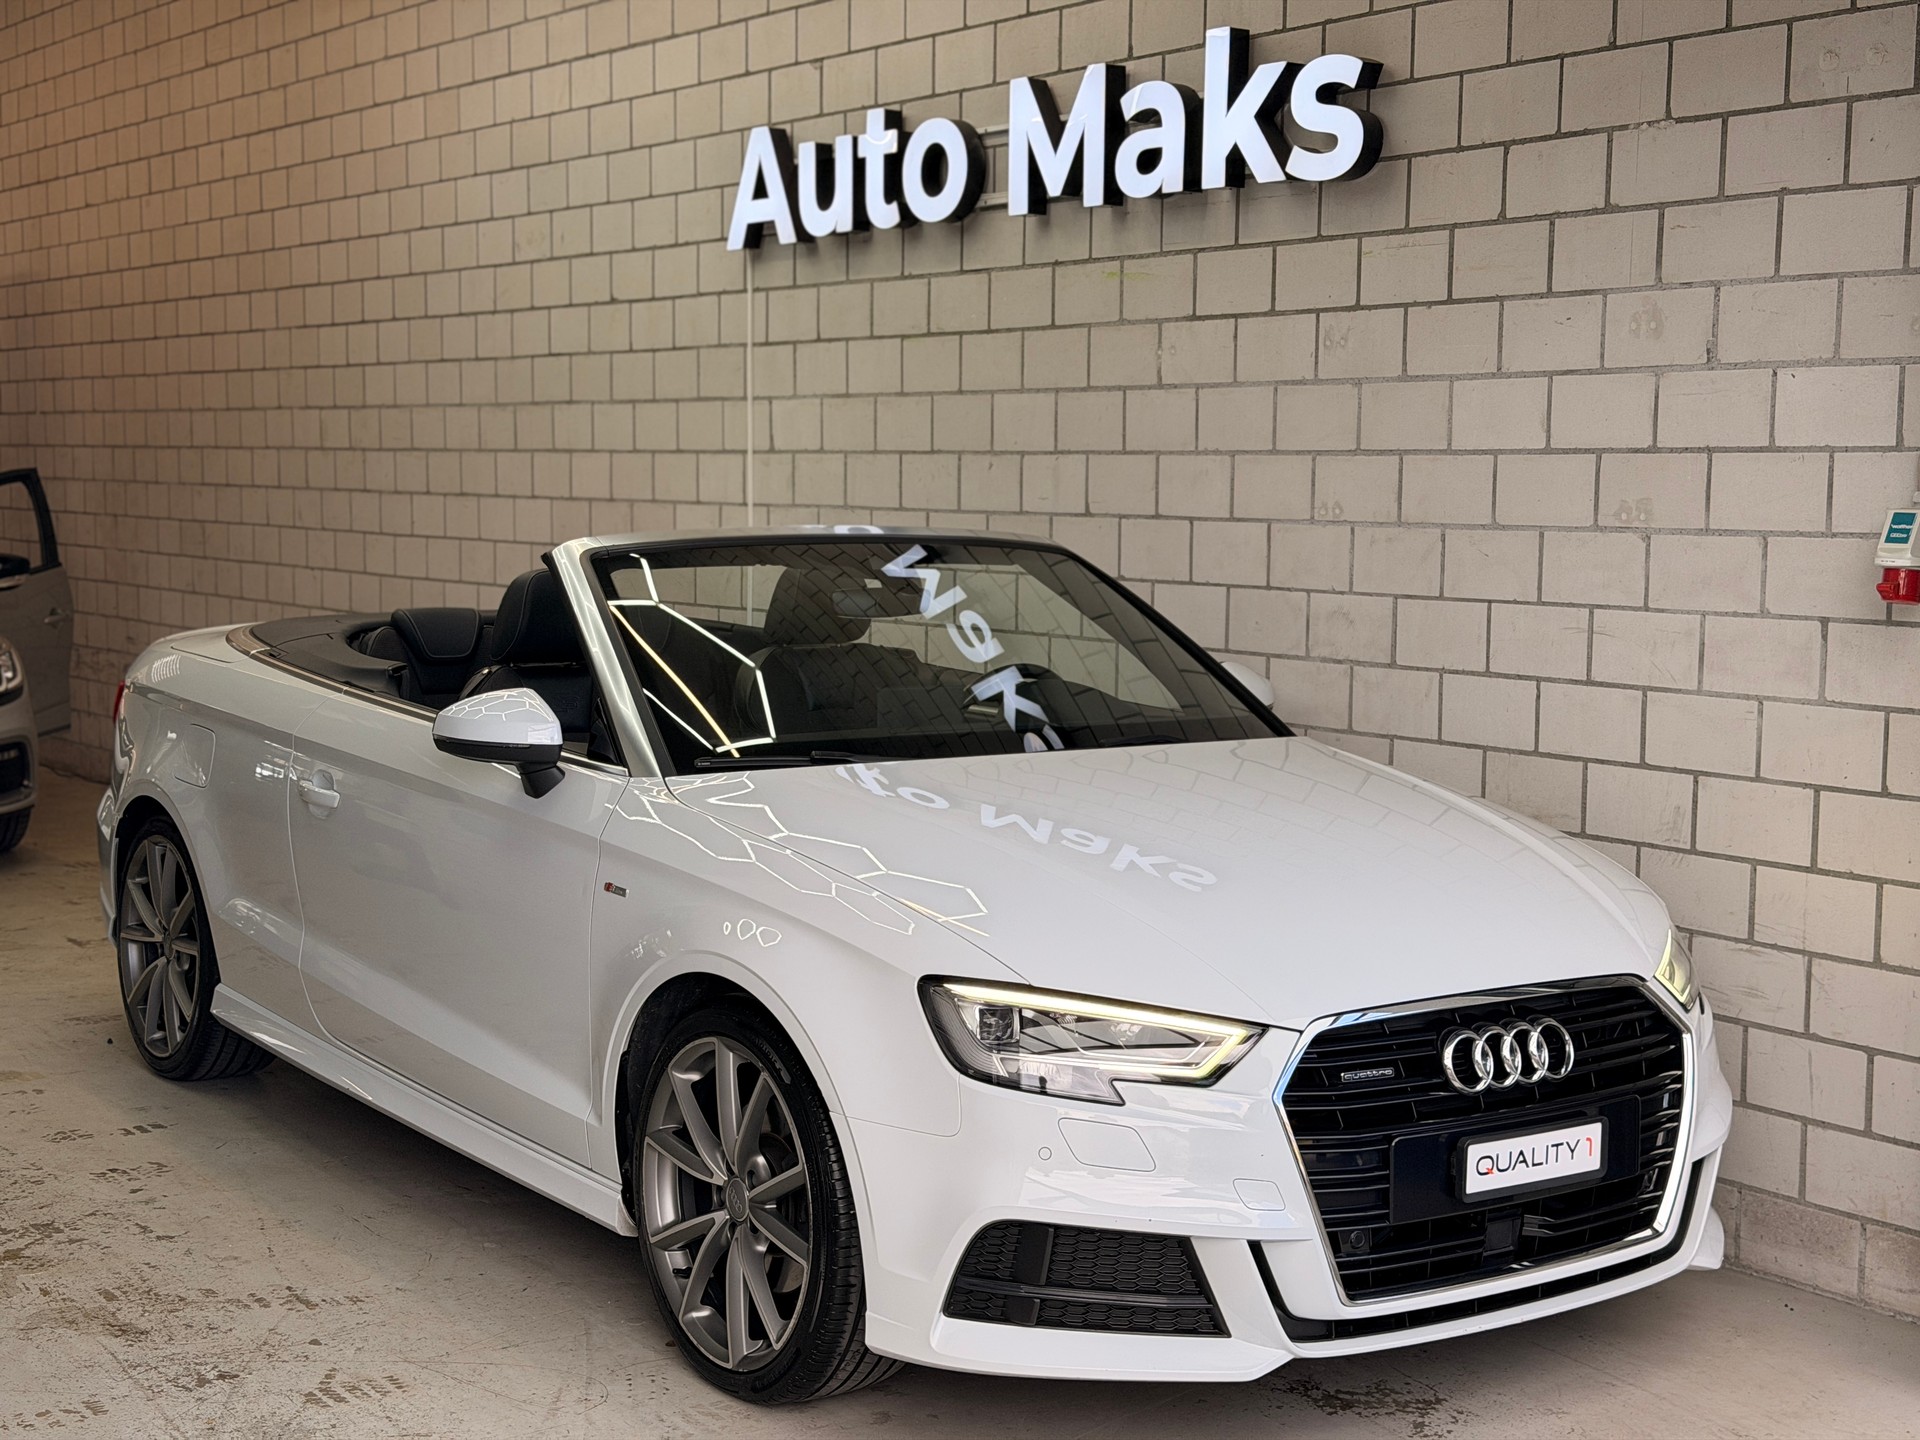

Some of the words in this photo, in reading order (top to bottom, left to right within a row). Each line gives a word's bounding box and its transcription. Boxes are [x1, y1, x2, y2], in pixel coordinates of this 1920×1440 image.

[727, 108, 969, 250] Auto
[1008, 26, 1365, 216] Maks
[1344, 1069, 1393, 1082] quattro
[1476, 1139, 1581, 1176] QUALITY
[1585, 1137, 1593, 1157] 1
